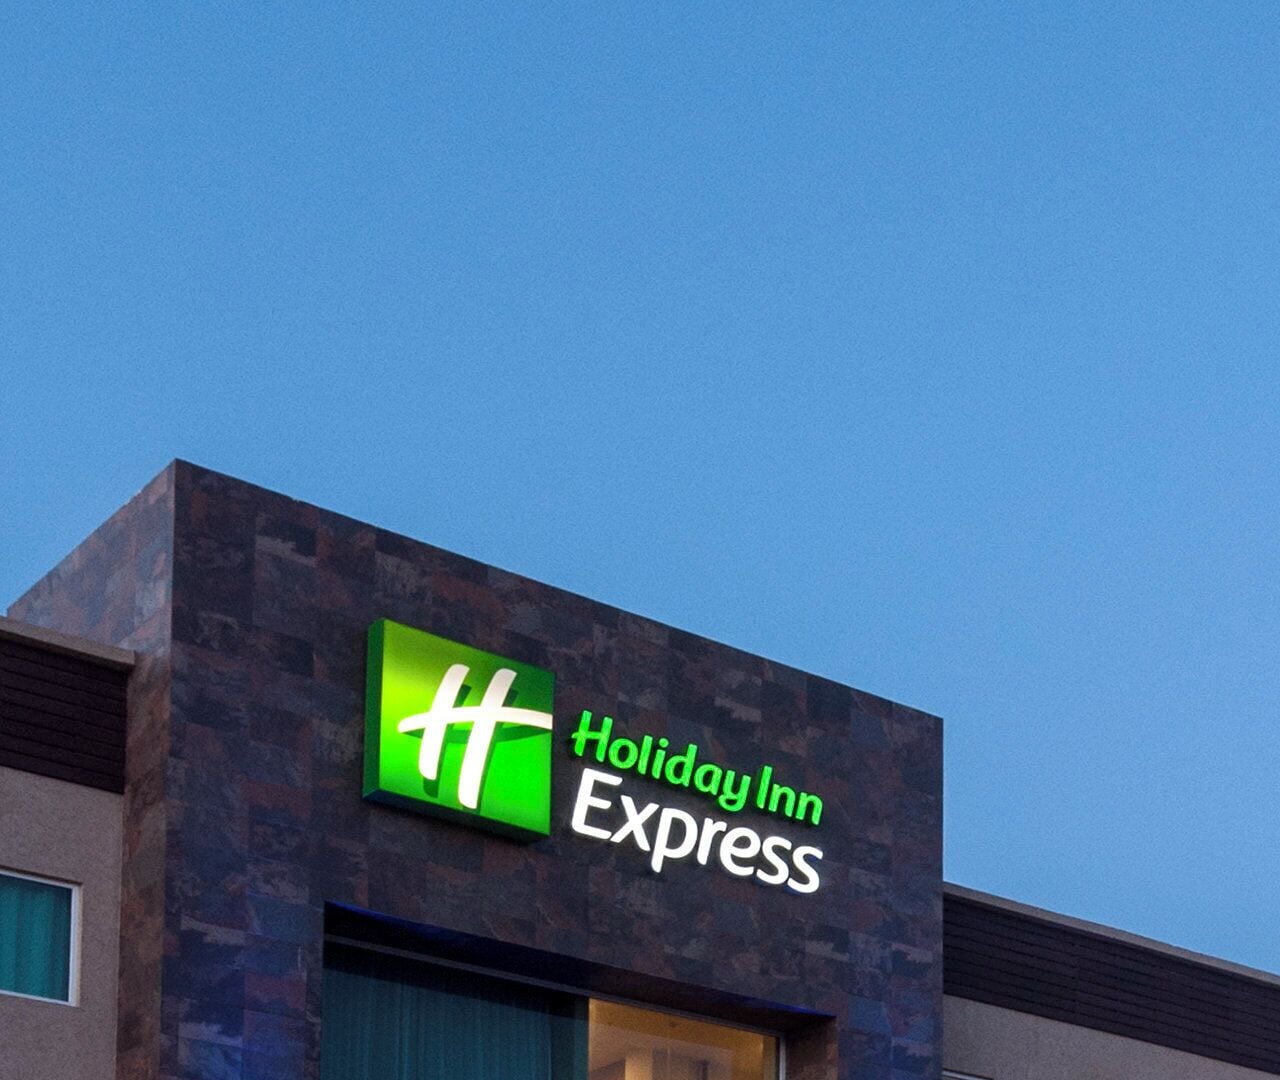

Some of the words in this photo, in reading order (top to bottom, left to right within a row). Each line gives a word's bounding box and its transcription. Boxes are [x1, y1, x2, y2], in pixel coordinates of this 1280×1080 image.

[571, 710, 751, 812] Holiday
[756, 765, 823, 826] Inn
[571, 767, 823, 893] Express
